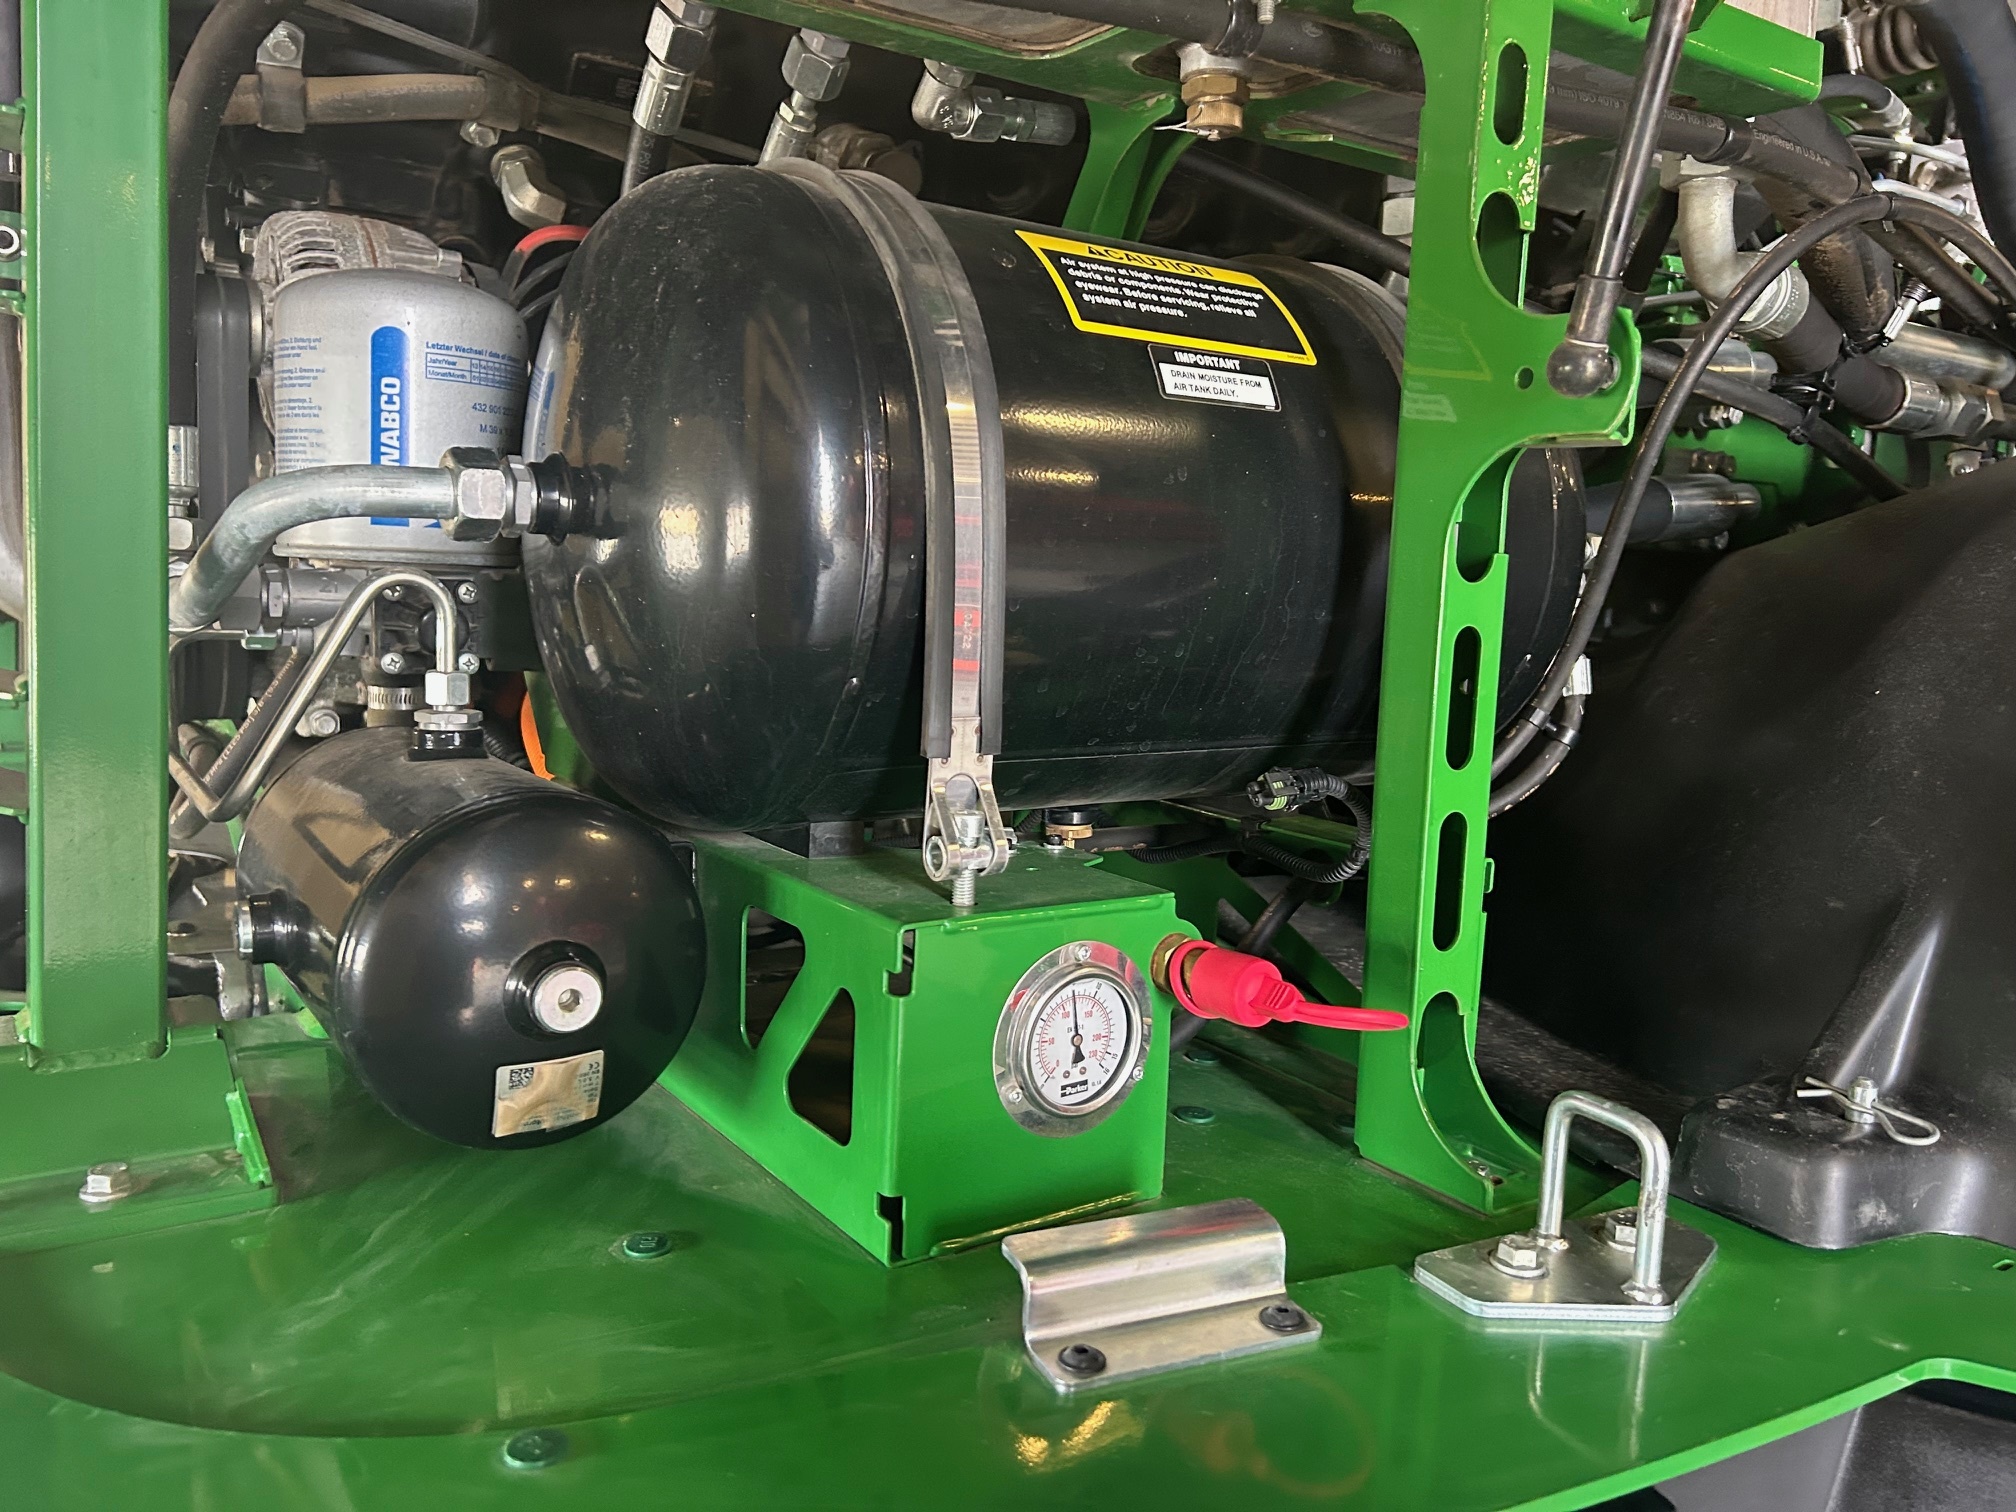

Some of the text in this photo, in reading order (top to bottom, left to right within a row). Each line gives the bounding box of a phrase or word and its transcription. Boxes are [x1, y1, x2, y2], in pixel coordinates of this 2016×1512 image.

[1105, 249, 1214, 277] CAUTION
[1060, 256, 1264, 300] Air system at high pressure can discharge
[1067, 268, 1103, 281] debris
[1118, 277, 1184, 295] components.
[1183, 288, 1210, 299] Wear
[1211, 293, 1260, 308] protective
[1075, 280, 1258, 318] eyewear. Before servicing, relieve all
[1082, 293, 1188, 318] system air pressure.
[425, 340, 453, 352] Letzter
[455, 344, 483, 356] Wechsel
[1174, 351, 1241, 371] IMPORTANT
[1170, 369, 1262, 389] DRAIN MOISTURE FROM
[1173, 382, 1239, 398] AIR TANK DAILY.
[471, 402, 487, 412] 432
[479, 424, 487, 433] M
[1061, 1011, 1071, 1019] 100
[1084, 1010, 1093, 1018] 150
[1048, 1037, 1055, 1045] 50
[1092, 1033, 1102, 1042] 200
[1088, 1050, 1098, 1059] 230
[1065, 1084, 1088, 1096] Parker
